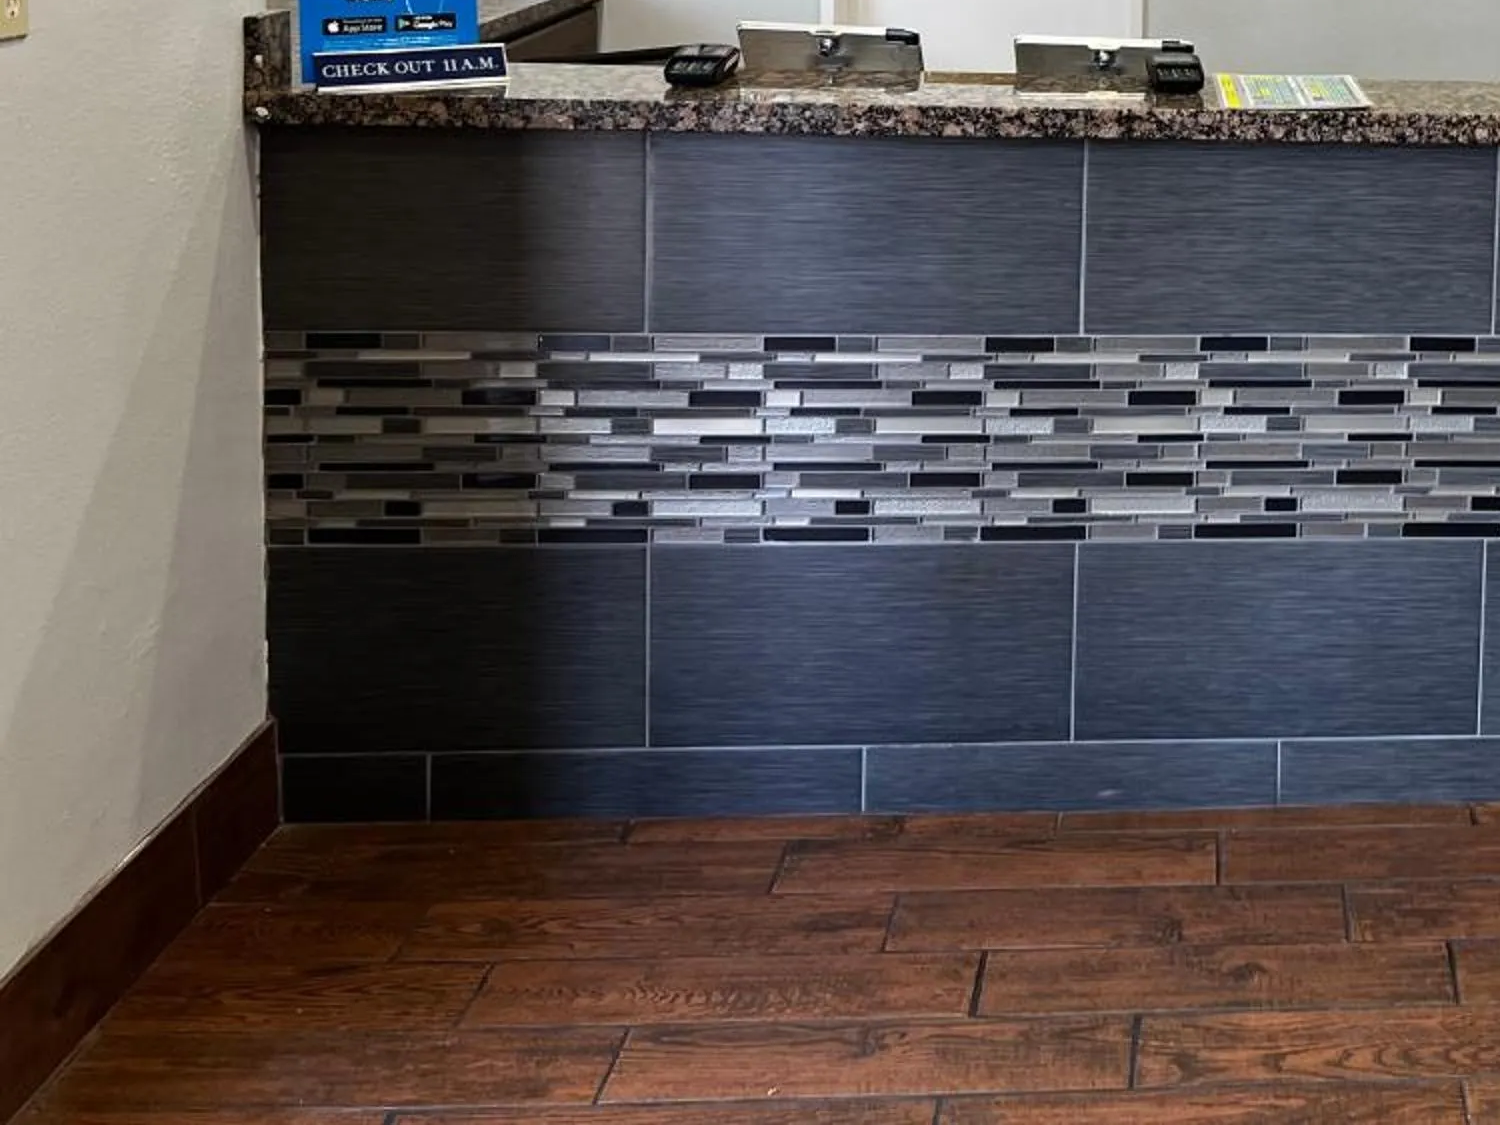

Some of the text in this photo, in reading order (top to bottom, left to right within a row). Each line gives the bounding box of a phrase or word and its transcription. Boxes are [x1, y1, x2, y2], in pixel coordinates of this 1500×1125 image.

[361, 23, 383, 32] Store
[321, 56, 499, 79] CHECK OUT 11 A.M.
